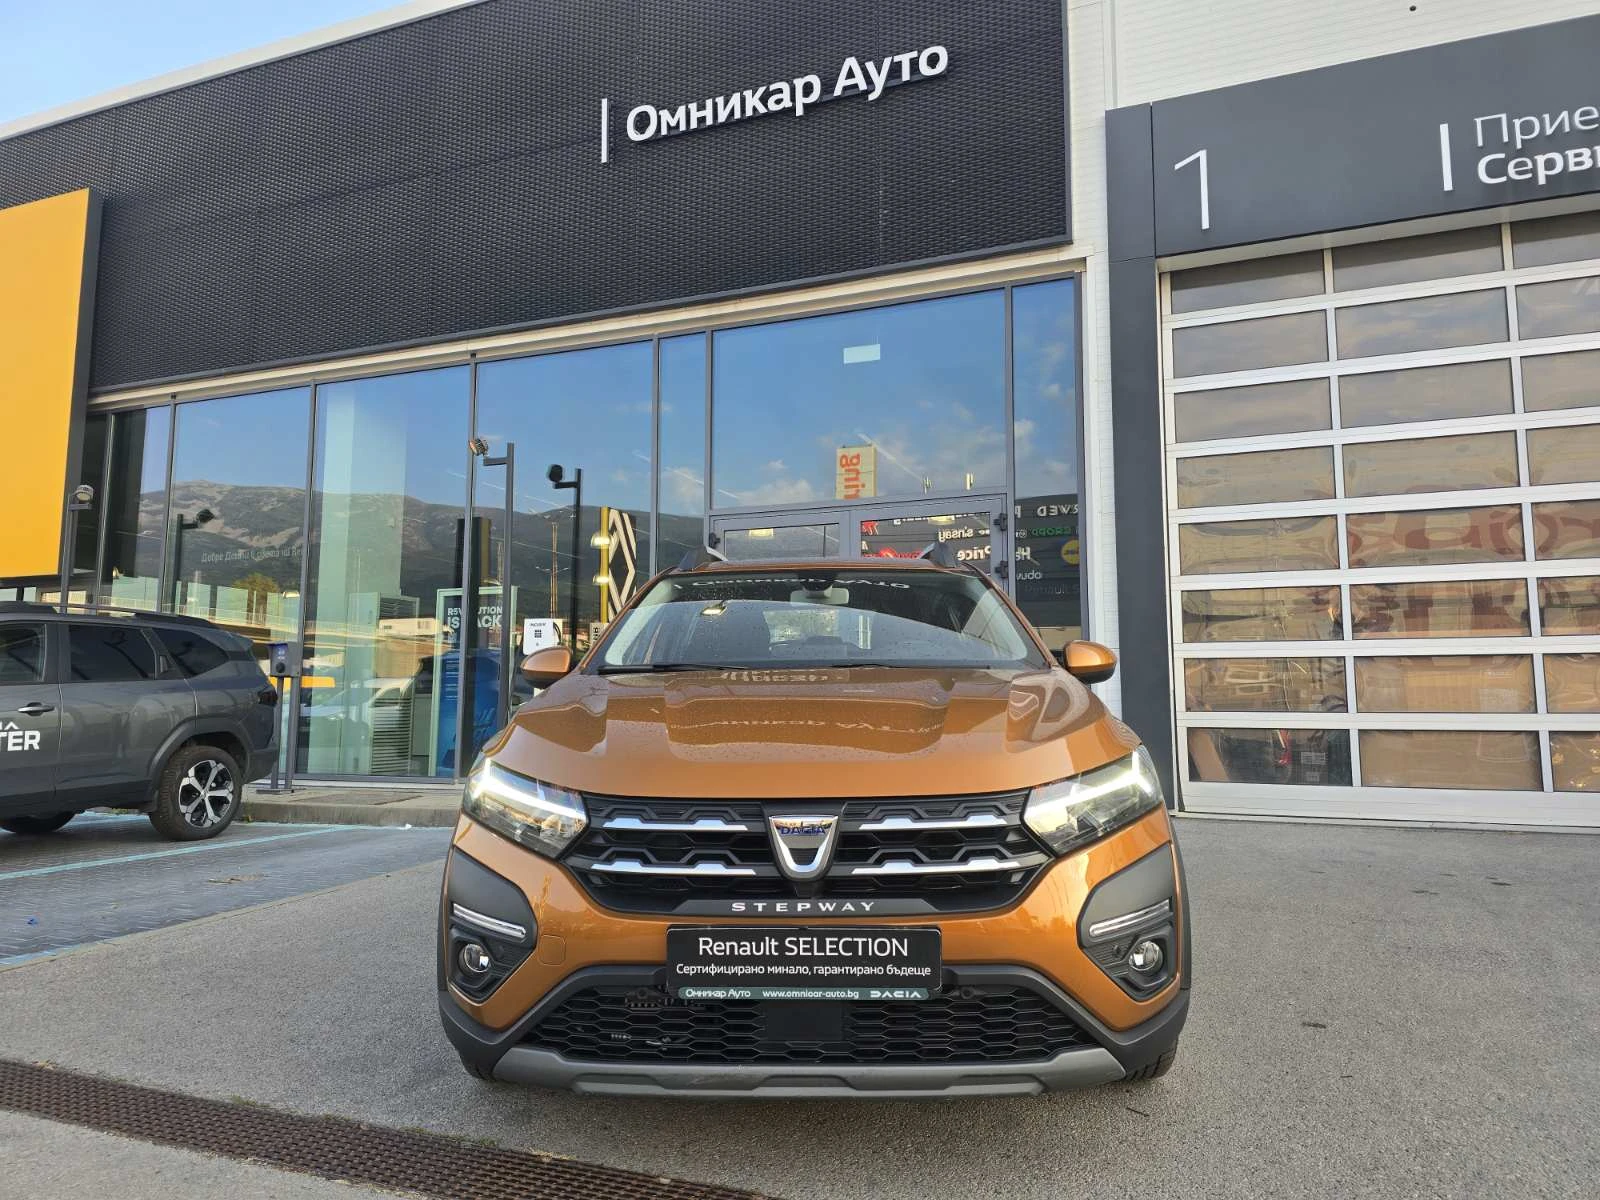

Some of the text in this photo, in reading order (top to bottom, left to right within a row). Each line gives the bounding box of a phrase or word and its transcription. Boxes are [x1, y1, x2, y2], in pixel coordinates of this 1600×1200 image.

[626, 45, 949, 142] Омникар Ауто
[1174, 149, 1210, 230] 1
[780, 826, 826, 835] DACIA
[731, 902, 875, 912] STEPWAY
[698, 936, 908, 957] Renault SELECTION
[676, 963, 932, 977] Сертифицирано минало, гарантирано бъдеще
[728, 988, 751, 999] Ауто
[870, 990, 922, 999] DACIA
